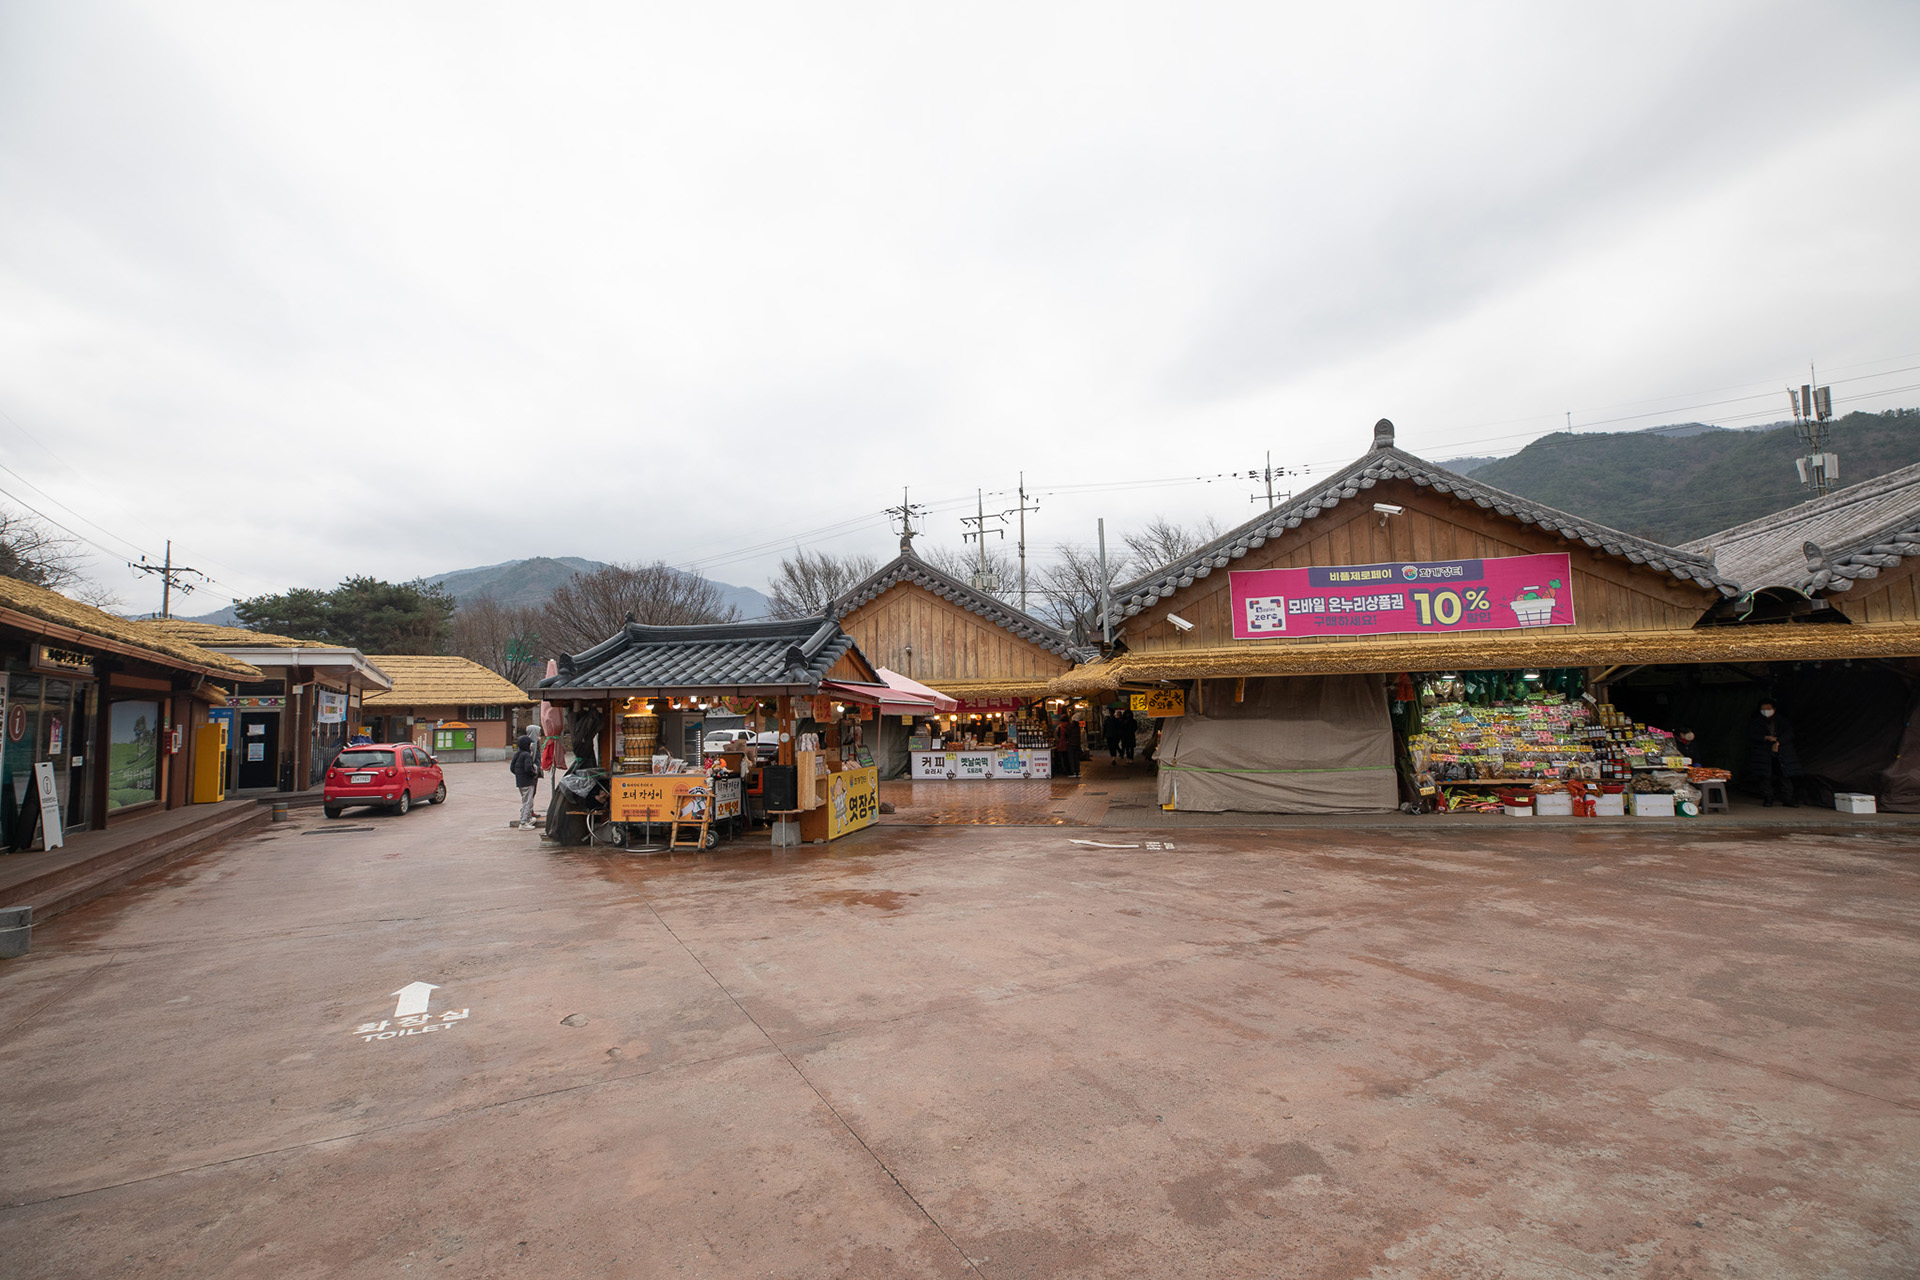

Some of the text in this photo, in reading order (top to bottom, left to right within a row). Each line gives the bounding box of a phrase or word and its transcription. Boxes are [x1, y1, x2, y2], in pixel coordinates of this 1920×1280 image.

[1329, 565, 1463, 582] 비플제로페이 화개장터
[1287, 592, 1405, 615] 모바일 온누리상품권
[1314, 615, 1377, 628] 구매하세요!
[1466, 611, 1491, 623] 할인
[921, 756, 945, 768] 커피
[849, 792, 876, 822] 엿장수
[352, 1008, 470, 1035] 화장실
[360, 1021, 459, 1042] TOILET
